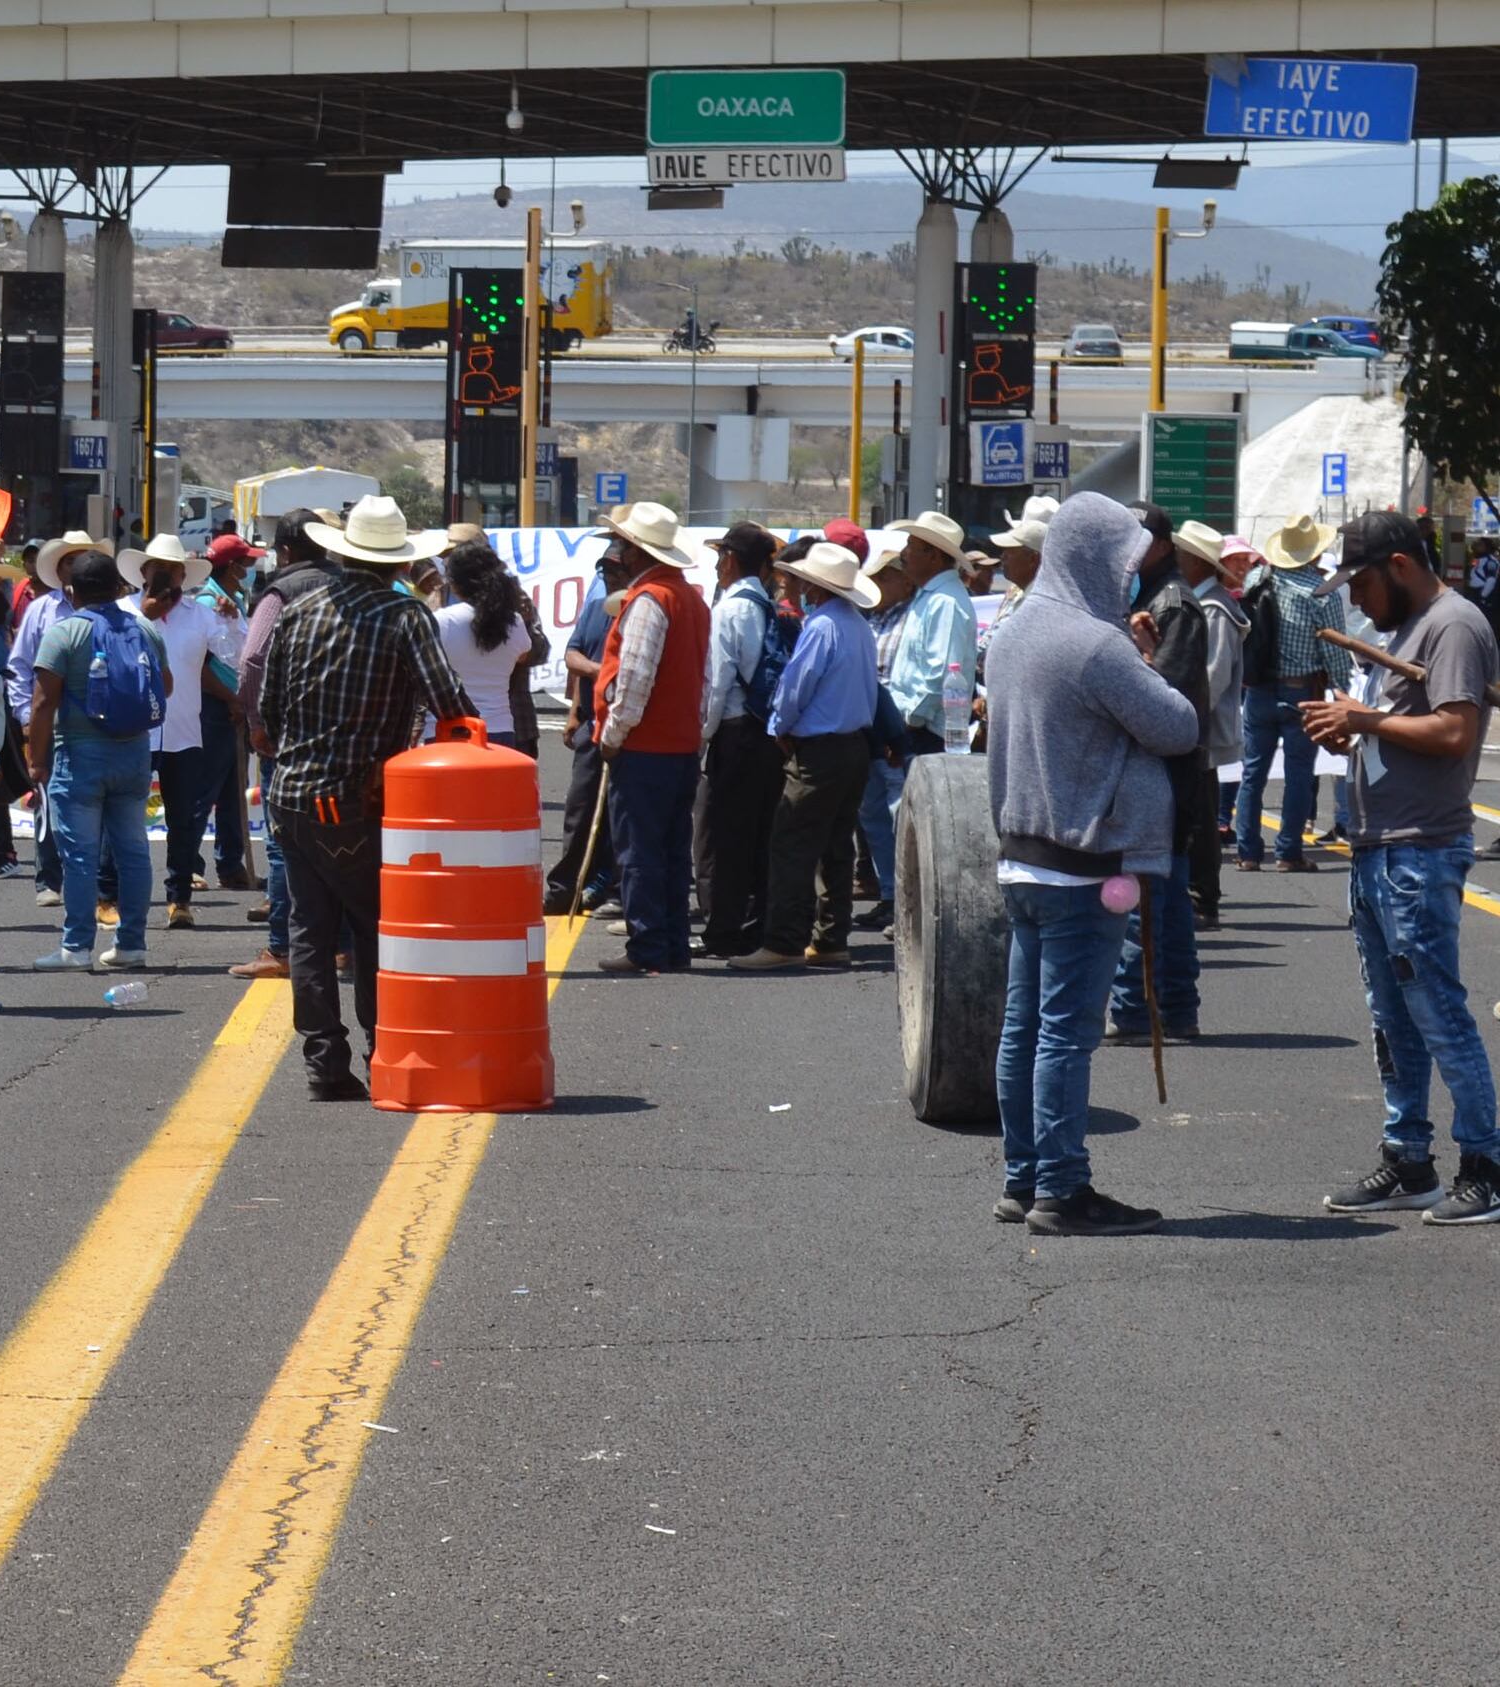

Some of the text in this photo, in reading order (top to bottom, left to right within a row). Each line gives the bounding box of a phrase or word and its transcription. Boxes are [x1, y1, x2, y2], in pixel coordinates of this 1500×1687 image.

[1278, 64, 1341, 91] IAVE
[697, 97, 795, 117] OAXACA
[1302, 91, 1314, 109] Y
[1243, 107, 1370, 138] EFECTIVO
[655, 153, 832, 179] IAVE EFECTIVO
[97, 438, 104, 458] A
[1325, 455, 1343, 492] E
[601, 476, 622, 502] E
